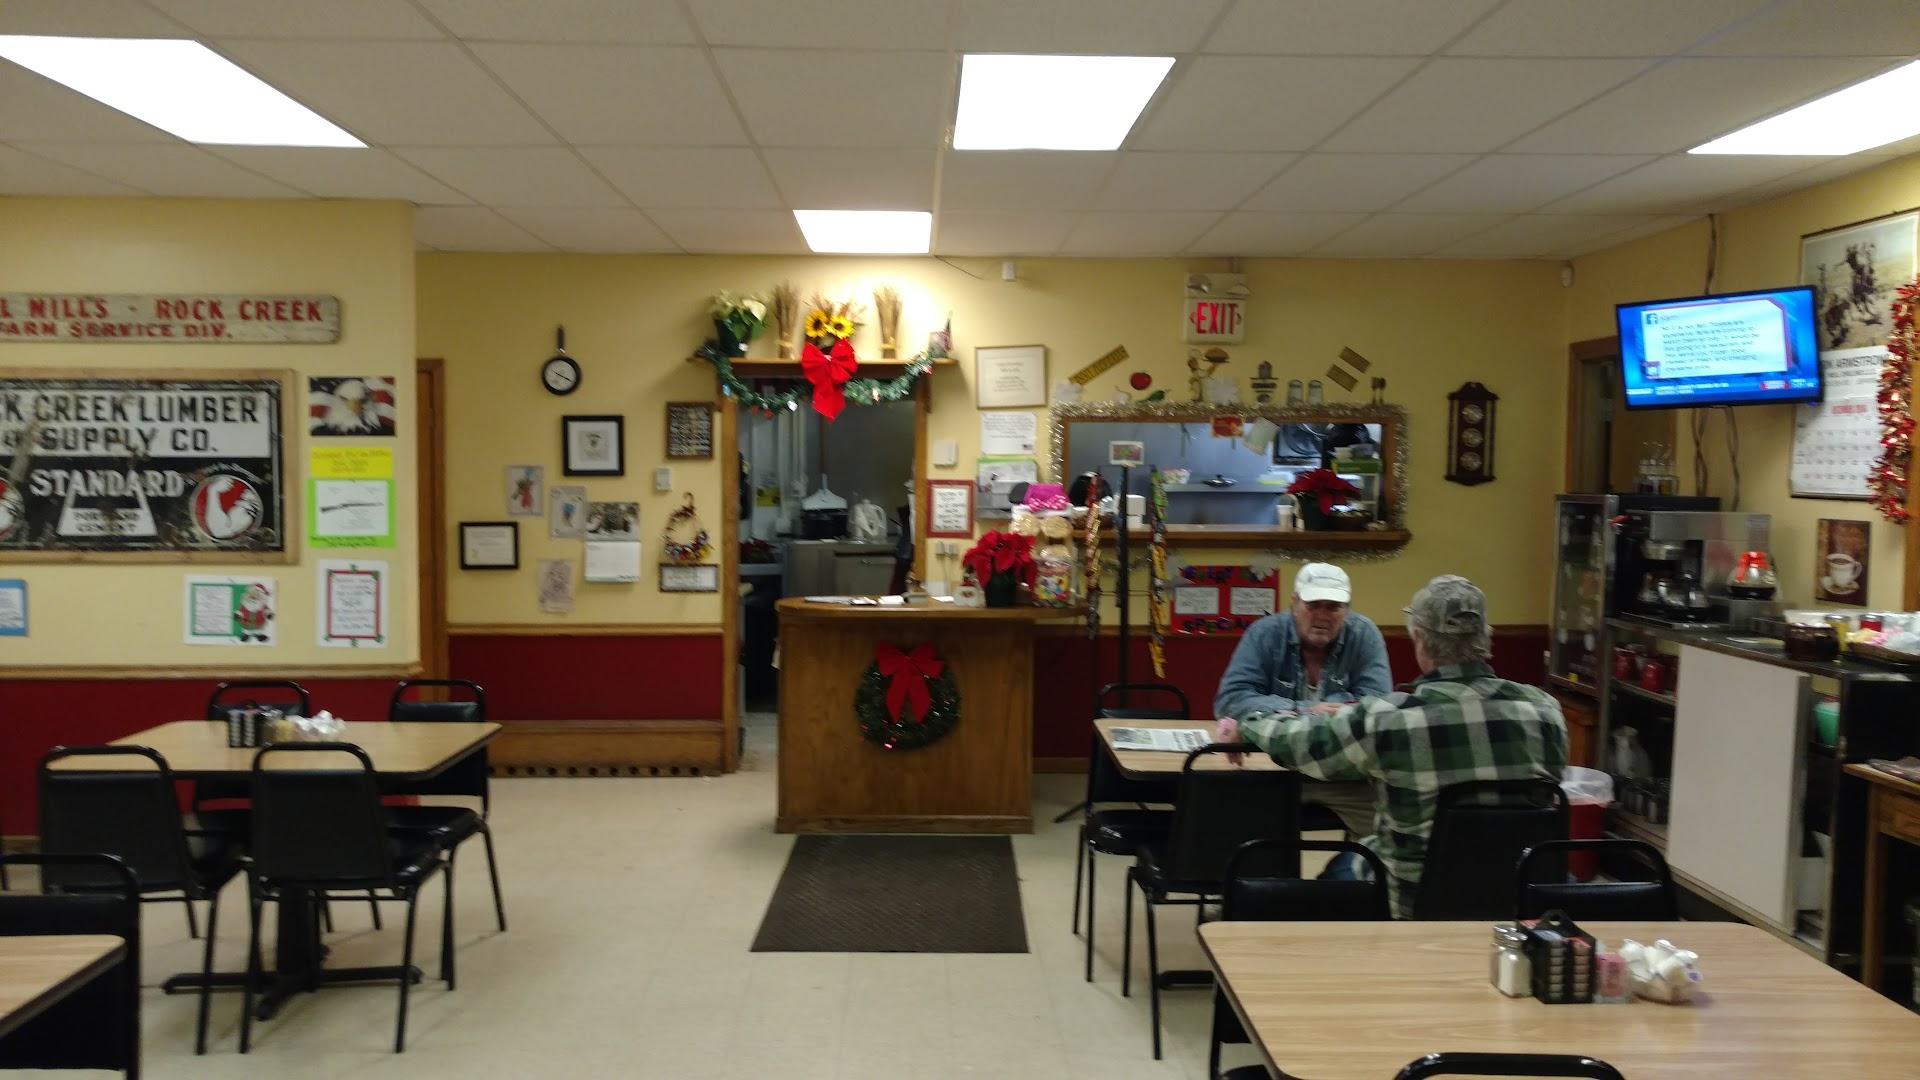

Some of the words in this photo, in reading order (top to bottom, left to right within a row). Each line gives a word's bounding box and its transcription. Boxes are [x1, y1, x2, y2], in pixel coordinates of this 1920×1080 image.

[156, 299, 224, 321] ROCK
[239, 299, 323, 322] CREEK
[1196, 302, 1239, 334] EXIT
[68, 321, 173, 338] SERVICE
[184, 324, 233, 339] DIV.
[35, 393, 129, 422] CREEK
[138, 395, 259, 423] LUMBER
[39, 426, 158, 452] SUPPLY
[171, 427, 218, 452] CO.
[28, 468, 185, 498] STANDARD
